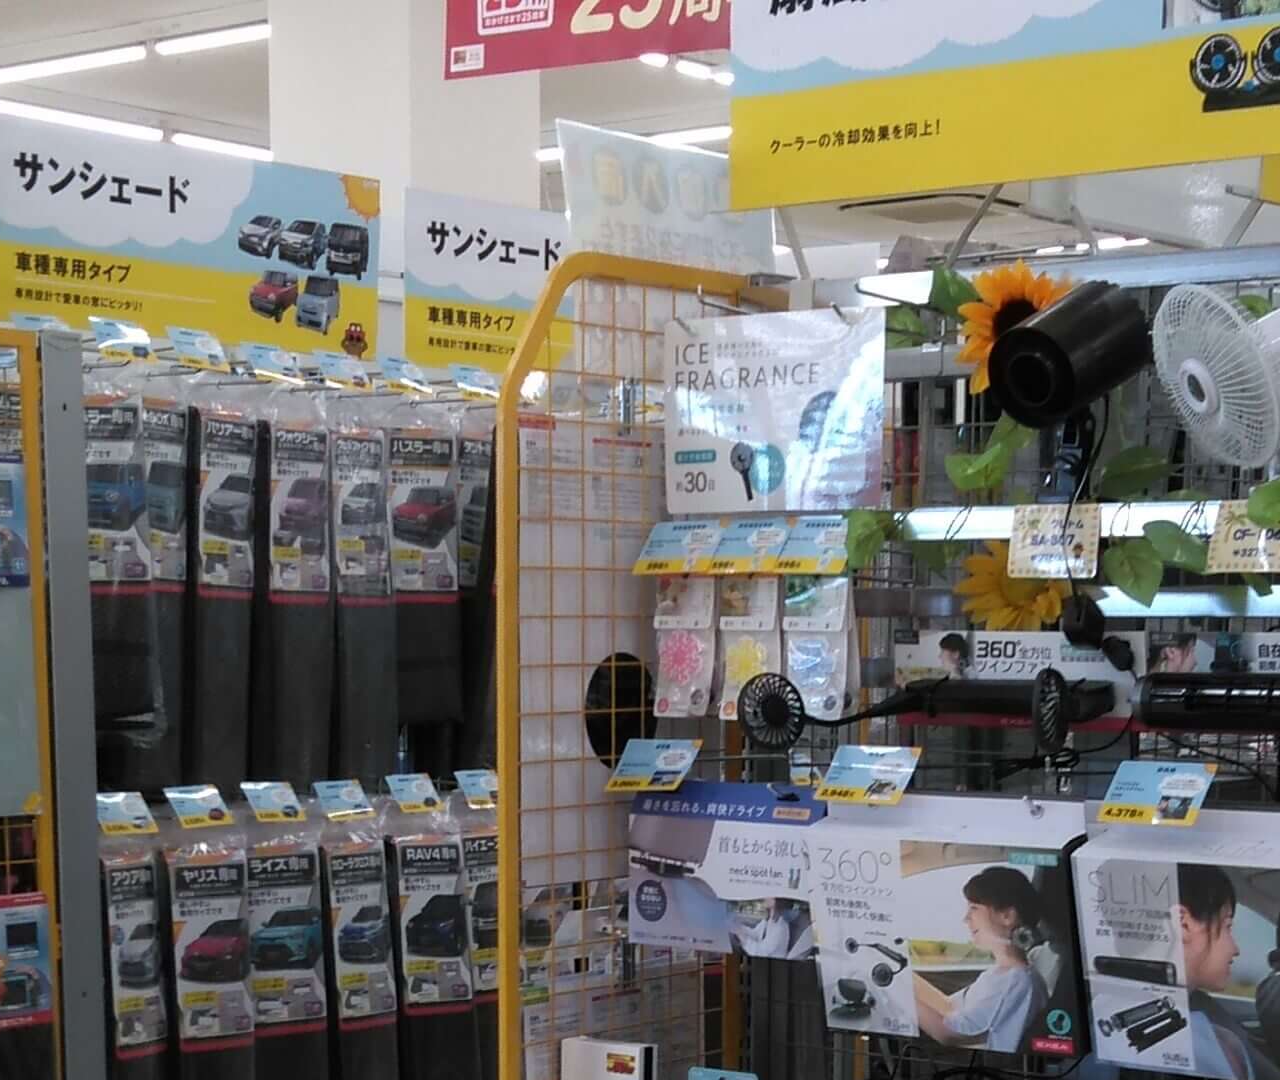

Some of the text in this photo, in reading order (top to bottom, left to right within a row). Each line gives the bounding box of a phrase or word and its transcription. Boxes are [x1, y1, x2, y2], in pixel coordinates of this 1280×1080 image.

[770, 118, 941, 155] クーラーの冷却効果を向上!
[13, 152, 190, 214] サンシェード
[426, 220, 562, 271] サンシェード
[16, 252, 131, 283] 車種専用タイプ
[427, 305, 515, 333] 車種専用タイプ
[675, 343, 710, 366] ICE
[675, 363, 820, 391] FRAGRANCE
[1088, 870, 1171, 906] SLIM
